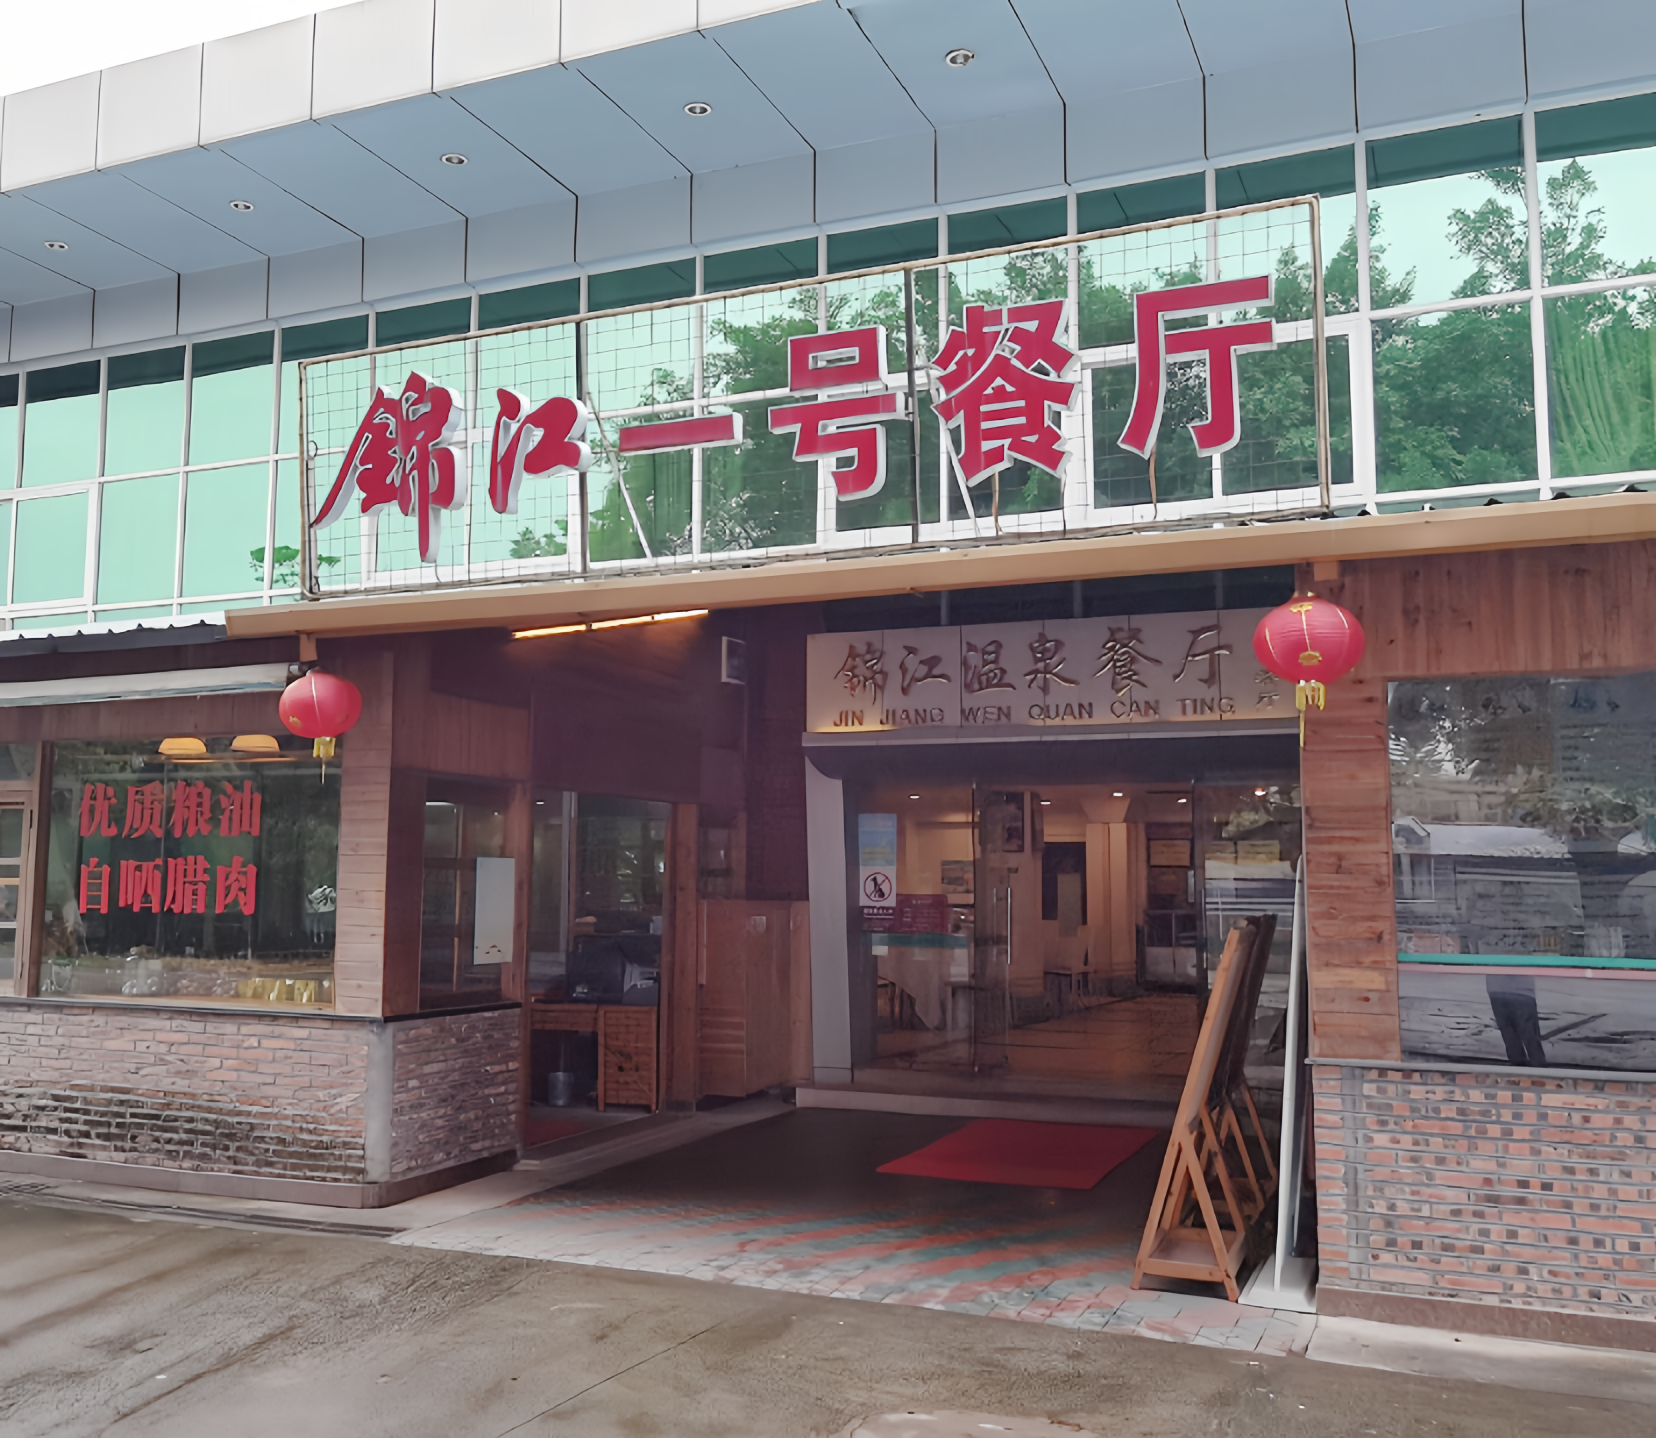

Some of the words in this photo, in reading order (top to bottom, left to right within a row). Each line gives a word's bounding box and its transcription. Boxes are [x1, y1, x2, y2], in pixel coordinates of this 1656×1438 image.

[833, 709, 865, 727] JIN
[879, 707, 945, 726] JIANG
[961, 705, 1012, 724] WEN
[1028, 701, 1094, 721] QUAN
[1110, 699, 1160, 719] CAN
[1176, 696, 1236, 716] TING
[79, 779, 262, 839] 优质粮油
[78, 854, 258, 916] 自晒腊肉
